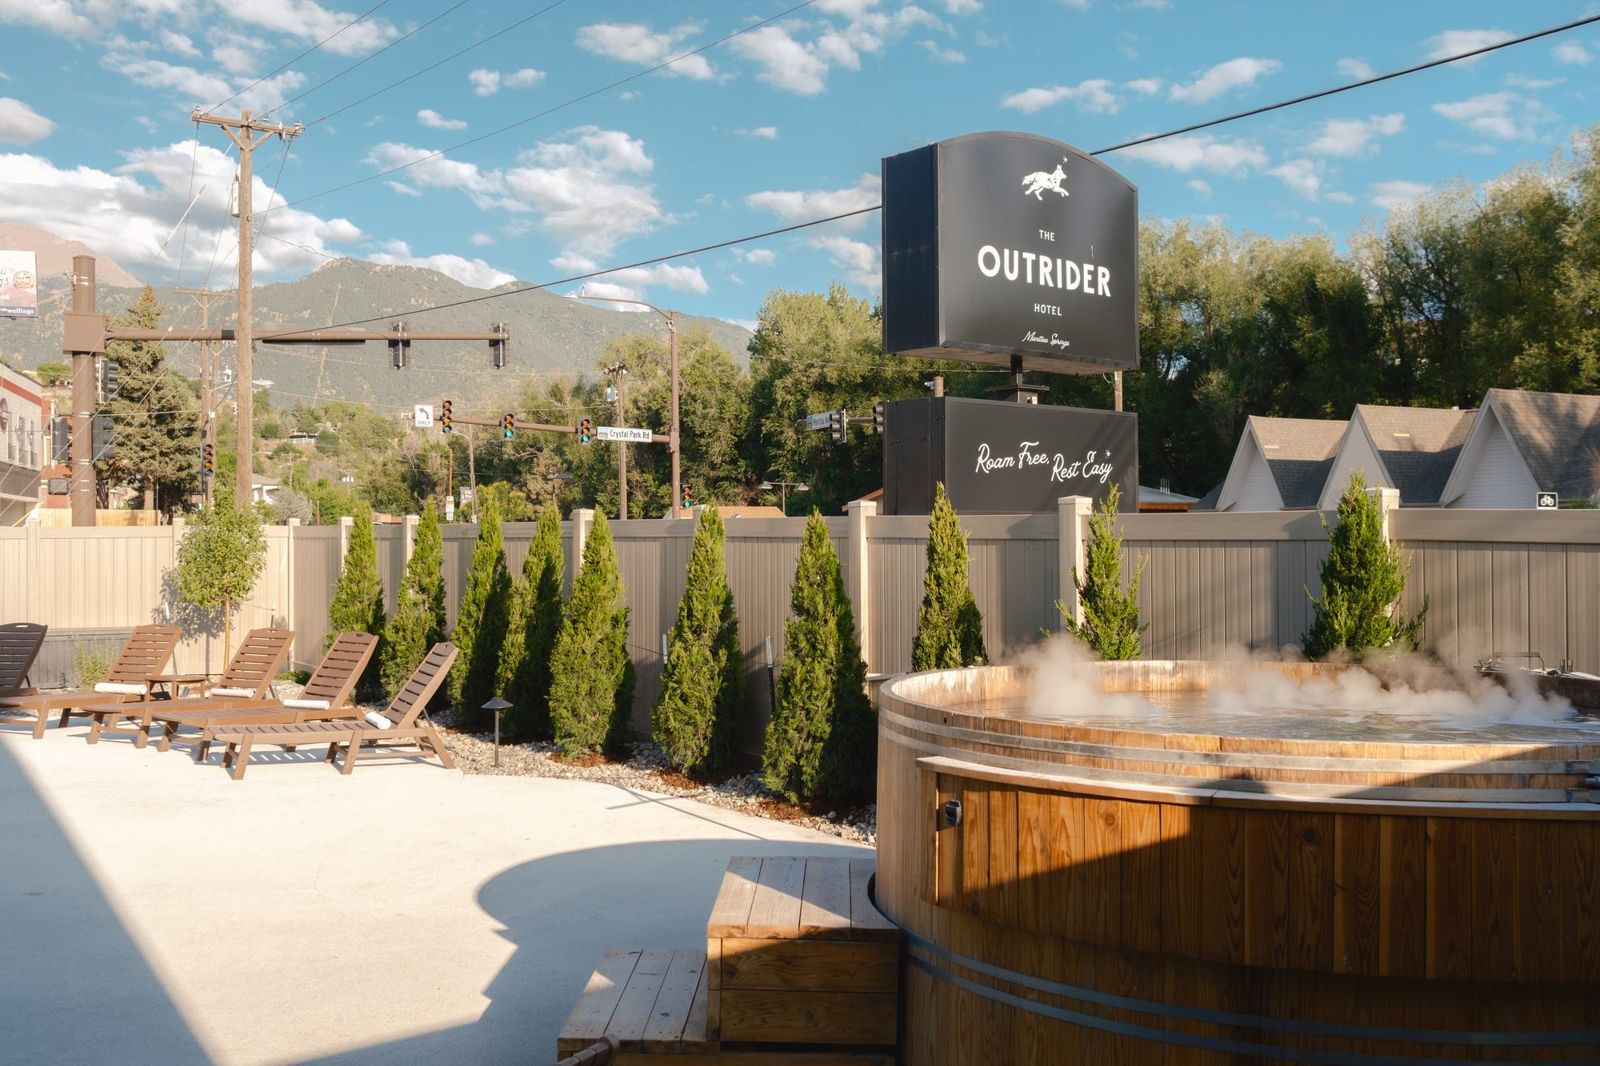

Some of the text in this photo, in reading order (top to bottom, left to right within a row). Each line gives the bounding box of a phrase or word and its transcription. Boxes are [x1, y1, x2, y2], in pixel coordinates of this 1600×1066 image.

[1038, 229, 1055, 241] THE
[977, 244, 1112, 298] OUTRIDER
[1033, 302, 1063, 316] HOTEL
[1050, 332, 1070, 350] Springs
[609, 429, 651, 440] Crystal Park Rd
[976, 440, 1114, 484] Roam Free, Rest Easy
